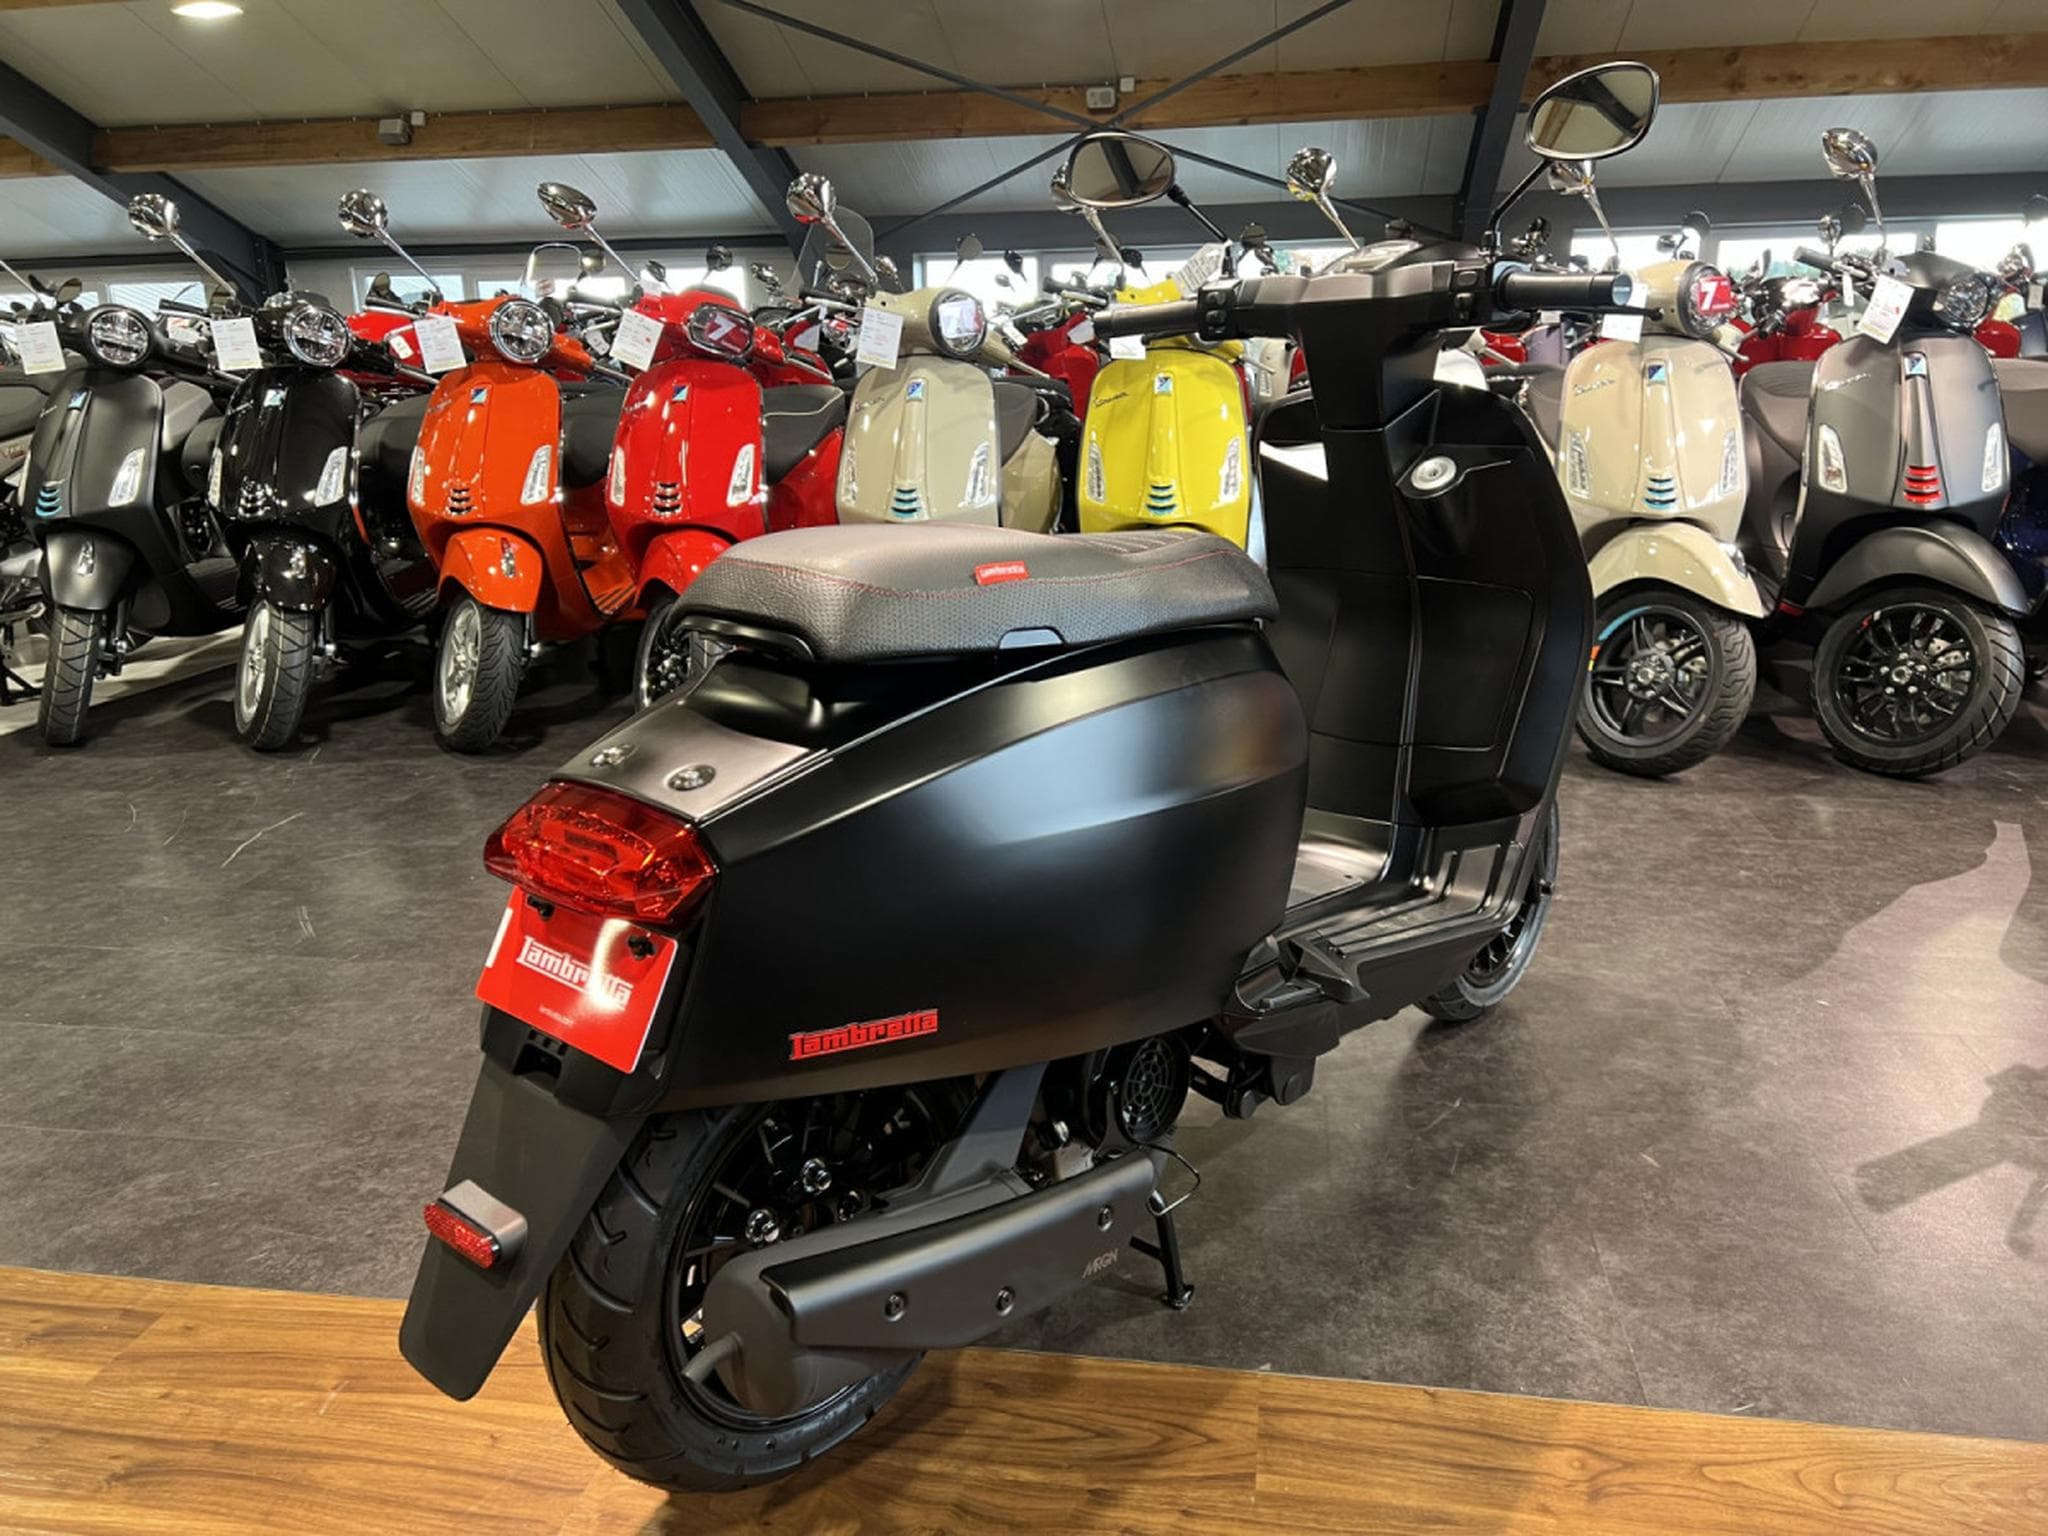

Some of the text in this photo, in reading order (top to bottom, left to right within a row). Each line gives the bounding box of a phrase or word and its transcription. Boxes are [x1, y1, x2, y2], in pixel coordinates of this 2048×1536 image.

[1700, 280, 1719, 311] 7
[708, 312, 737, 341] 7
[516, 935, 634, 1013] Lambrtta
[788, 1008, 939, 1061] Lambretta
